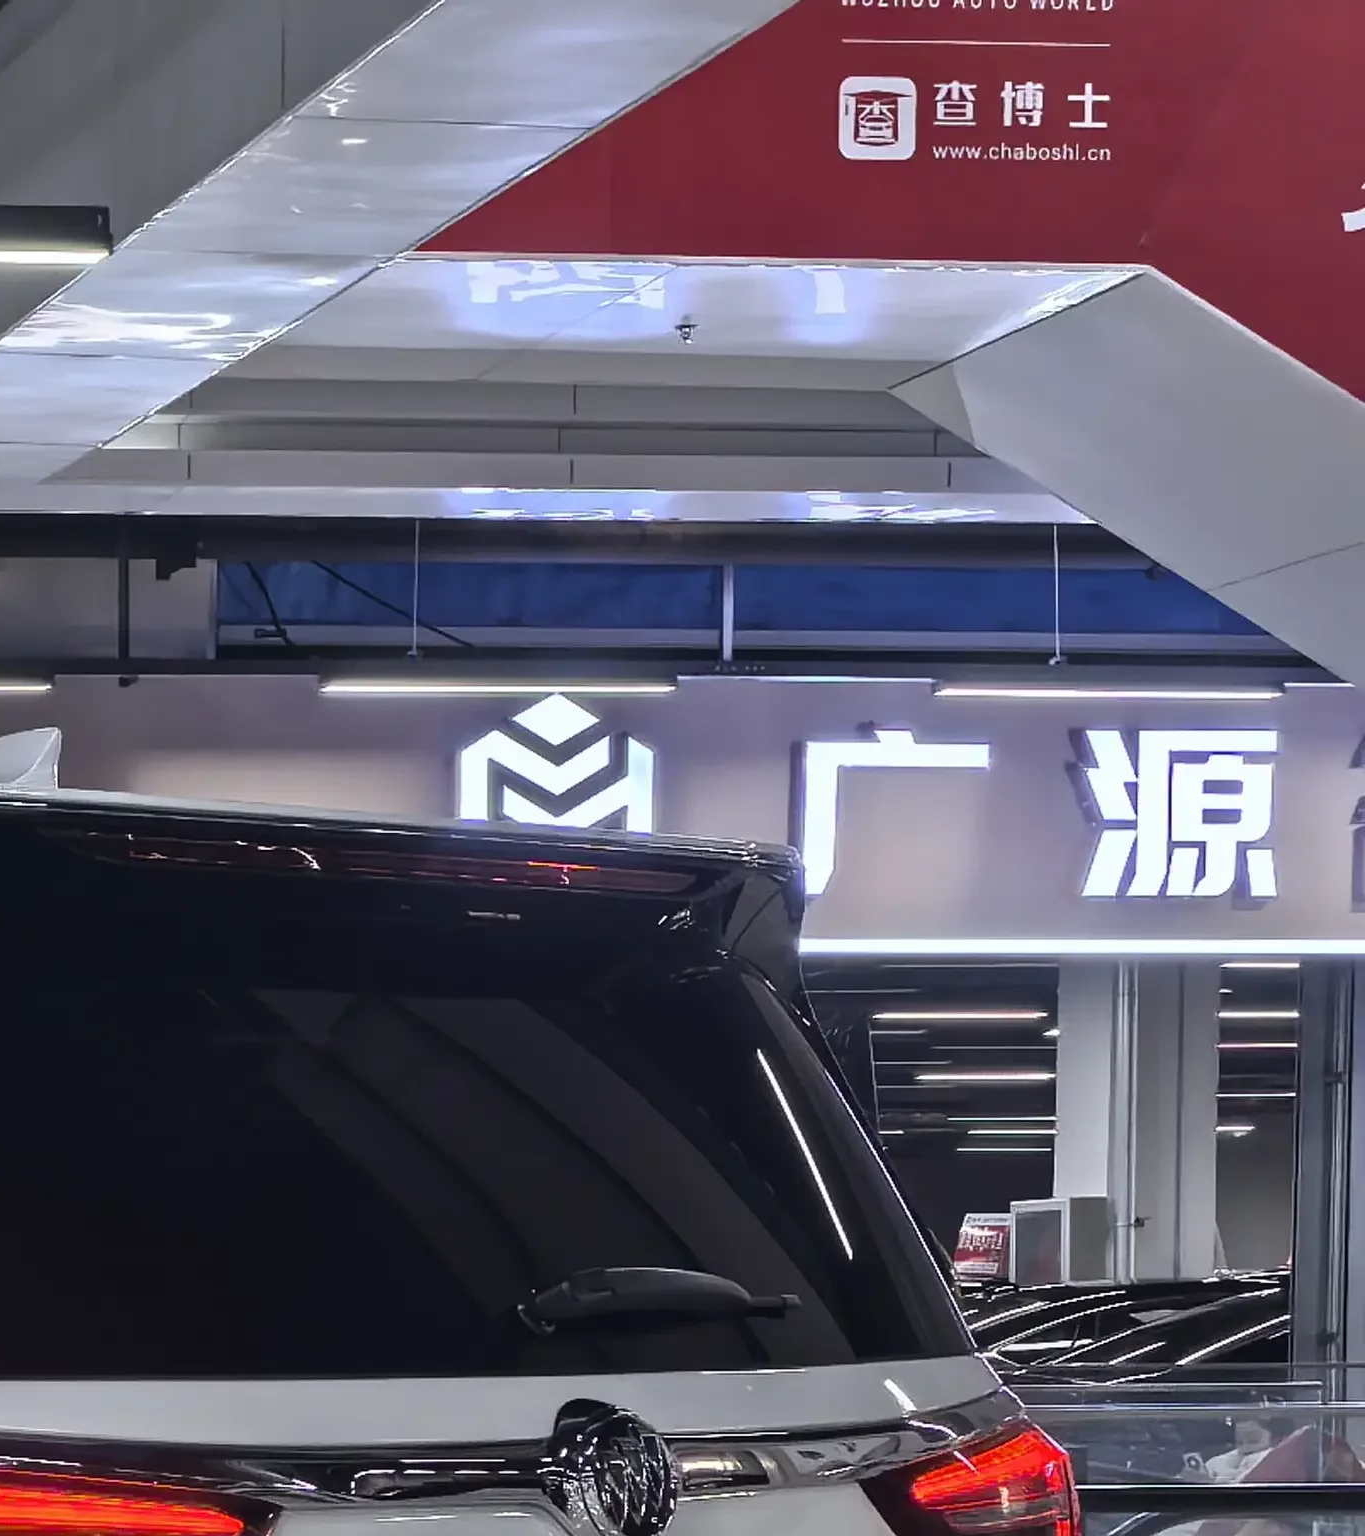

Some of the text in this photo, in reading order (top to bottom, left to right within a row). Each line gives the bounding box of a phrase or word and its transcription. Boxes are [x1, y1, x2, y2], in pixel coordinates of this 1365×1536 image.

[933, 80, 1111, 129] 查博士
[801, 726, 1365, 912] 广源
